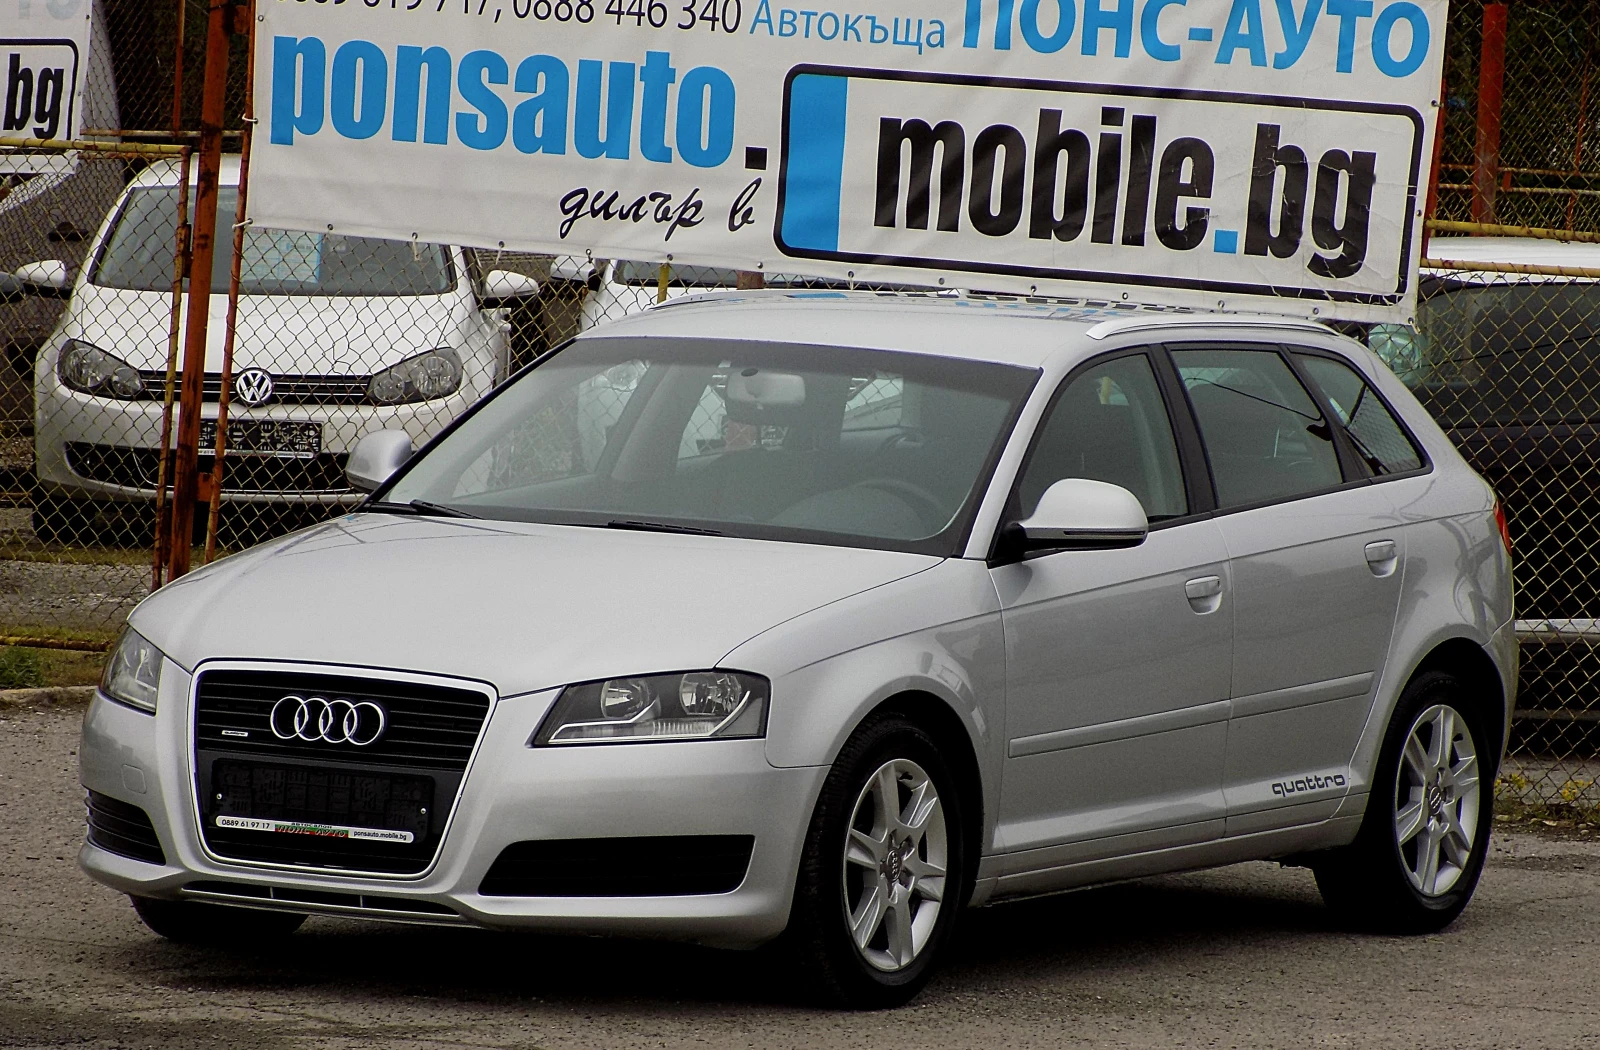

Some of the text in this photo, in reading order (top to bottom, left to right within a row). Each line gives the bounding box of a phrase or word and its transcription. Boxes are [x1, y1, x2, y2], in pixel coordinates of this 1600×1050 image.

[605, 0, 668, 28] 446
[677, 0, 742, 33] 340
[749, 0, 945, 55] Автокъща
[962, 0, 1430, 78] ПОНС-АУТО
[873, 107, 1377, 278] mobile.bg
[1272, 774, 1345, 797] quattro
